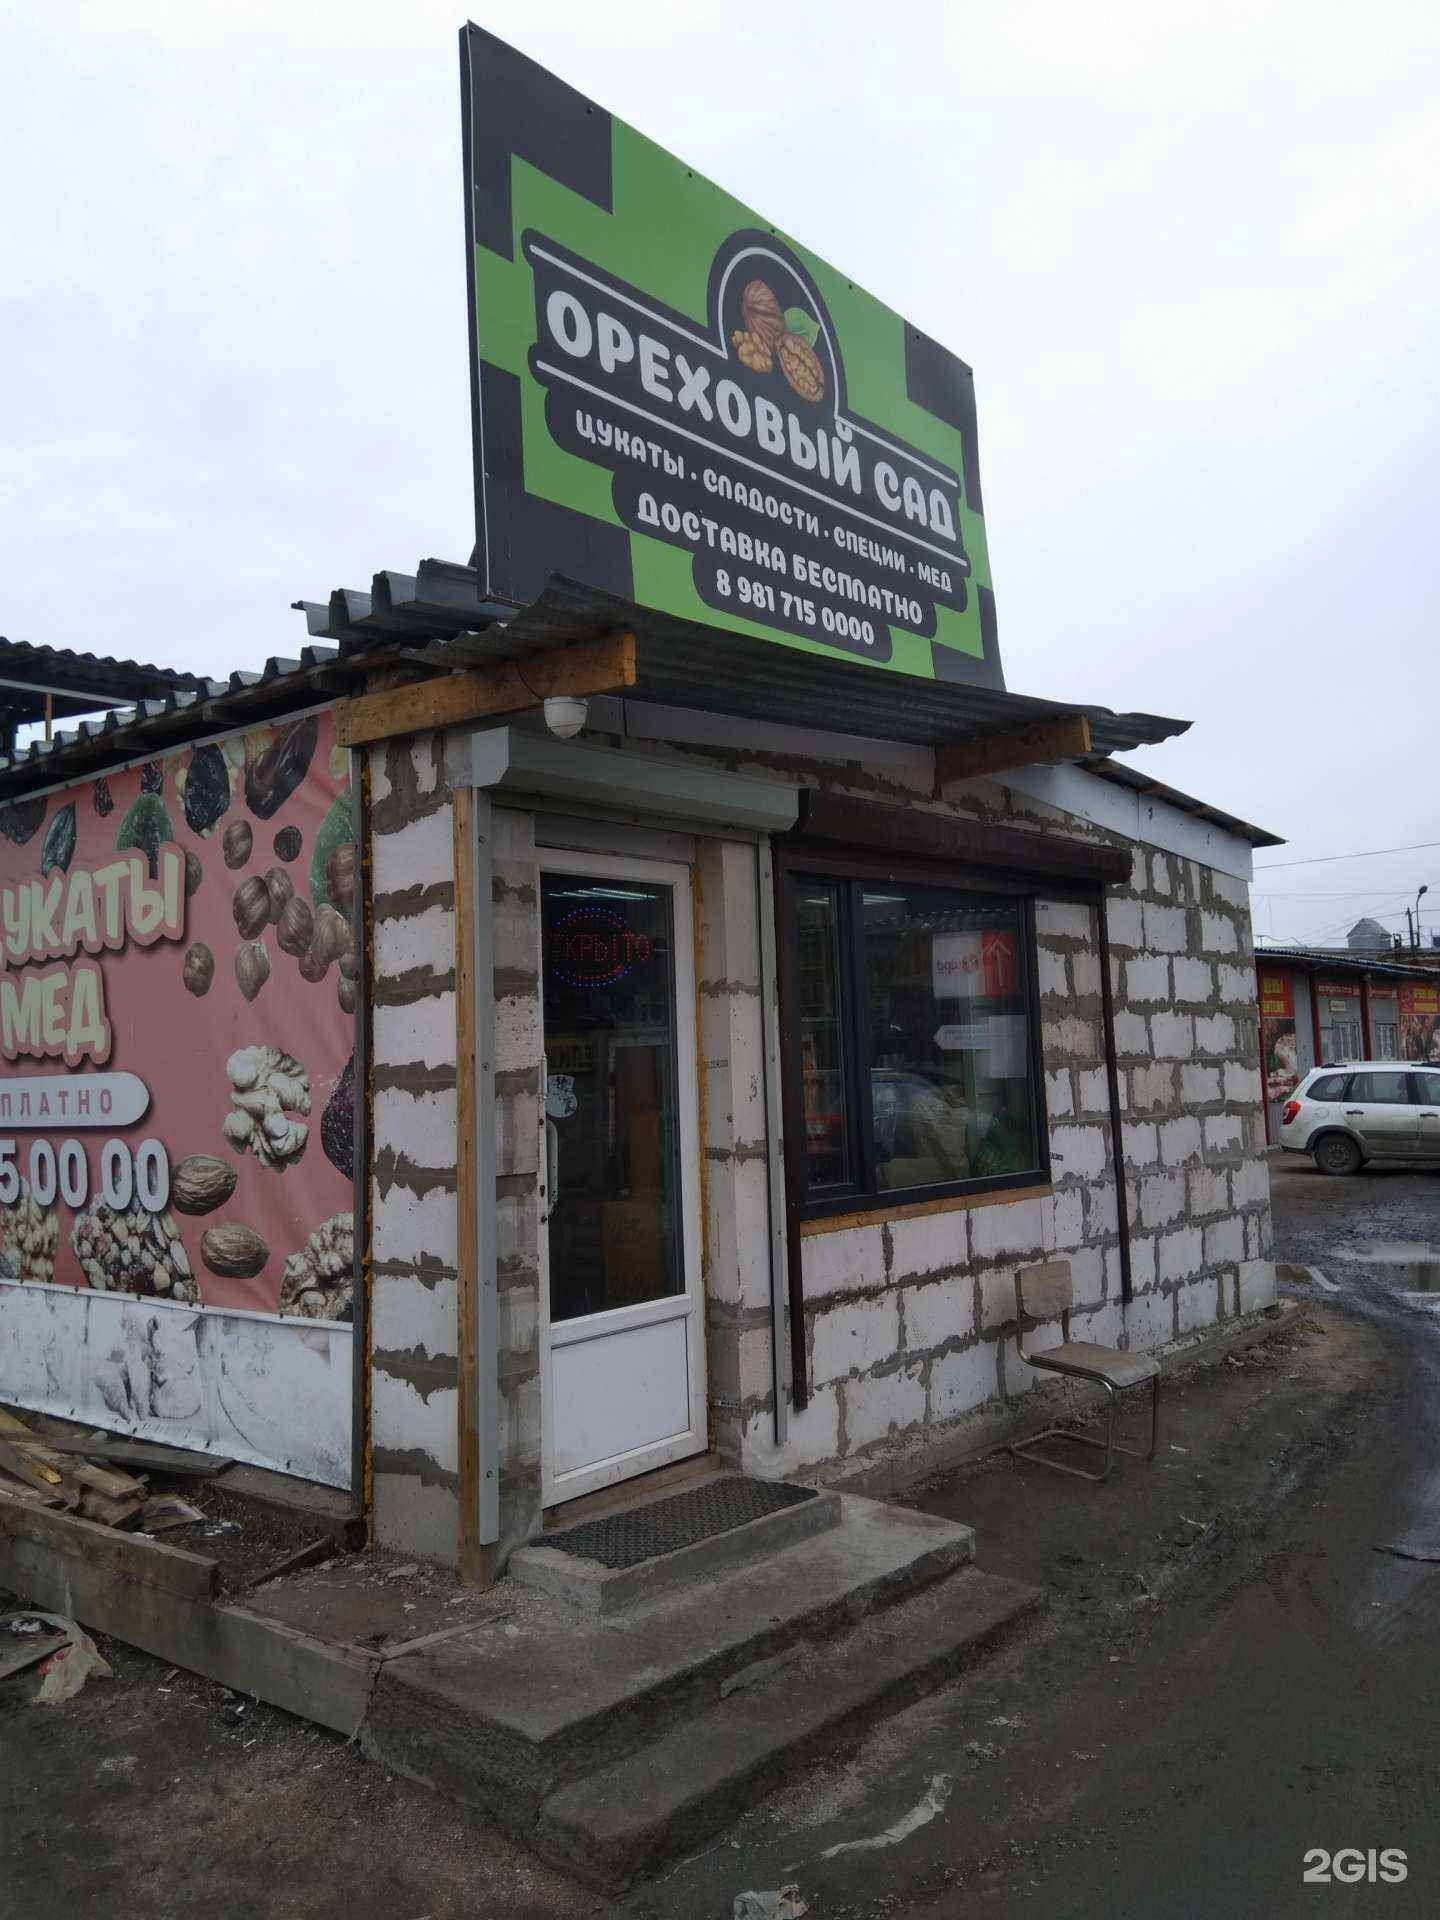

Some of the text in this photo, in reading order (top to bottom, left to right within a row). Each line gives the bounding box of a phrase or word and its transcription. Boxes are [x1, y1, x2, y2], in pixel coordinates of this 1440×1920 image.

[546, 290, 957, 542] ОРЕХОВЫЙ САД
[576, 409, 953, 593] ЦУКАТЫ СЛАДОСТИ СПЕЦИИ МЕД
[637, 492, 923, 625] ДОСТАВКА БЕСПЛАТНО
[715, 568, 876, 645] 8 981 715 0000
[0, 852, 180, 957] УКАТЫ
[0, 968, 106, 1056] МЕД
